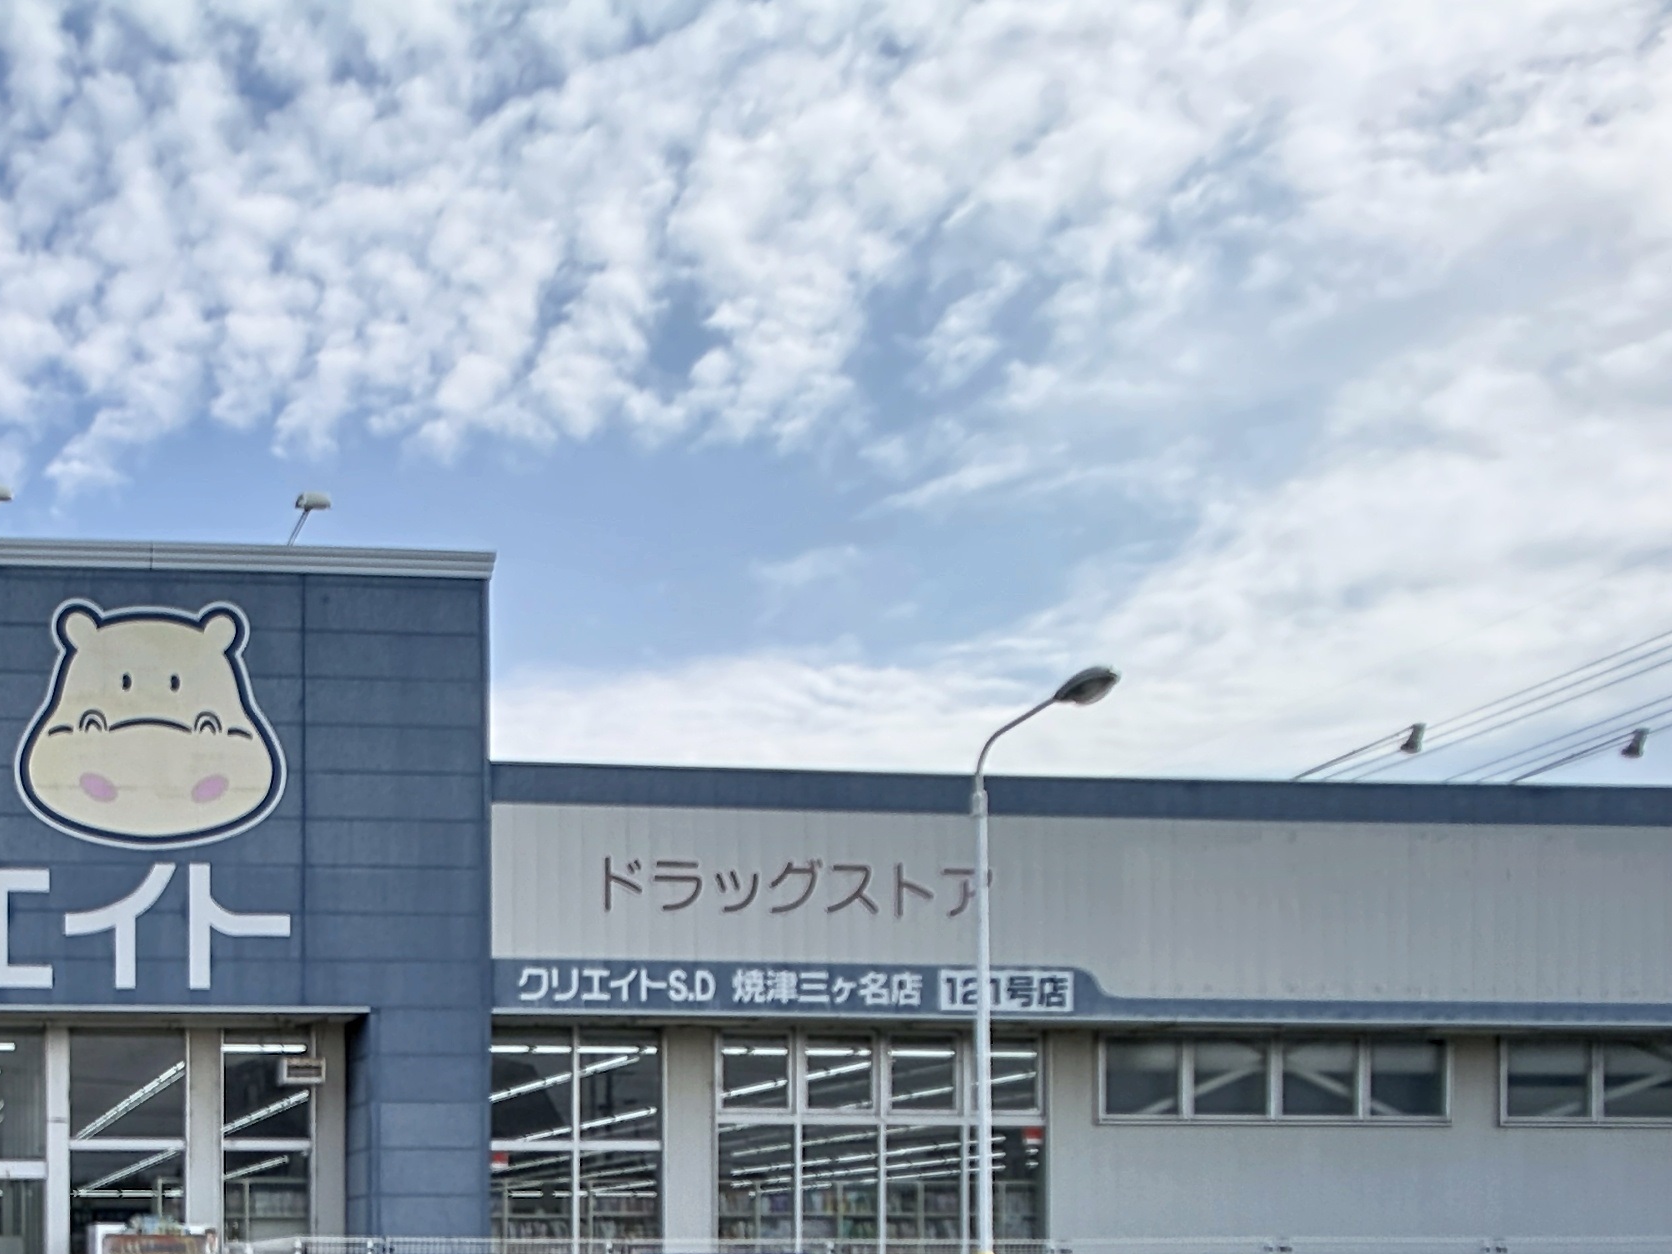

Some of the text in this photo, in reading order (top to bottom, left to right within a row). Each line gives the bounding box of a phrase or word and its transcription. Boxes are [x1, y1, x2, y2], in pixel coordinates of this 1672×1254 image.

[518, 966, 1069, 1008] クリエイトS.D 焼津三ヶ名店 121号店
